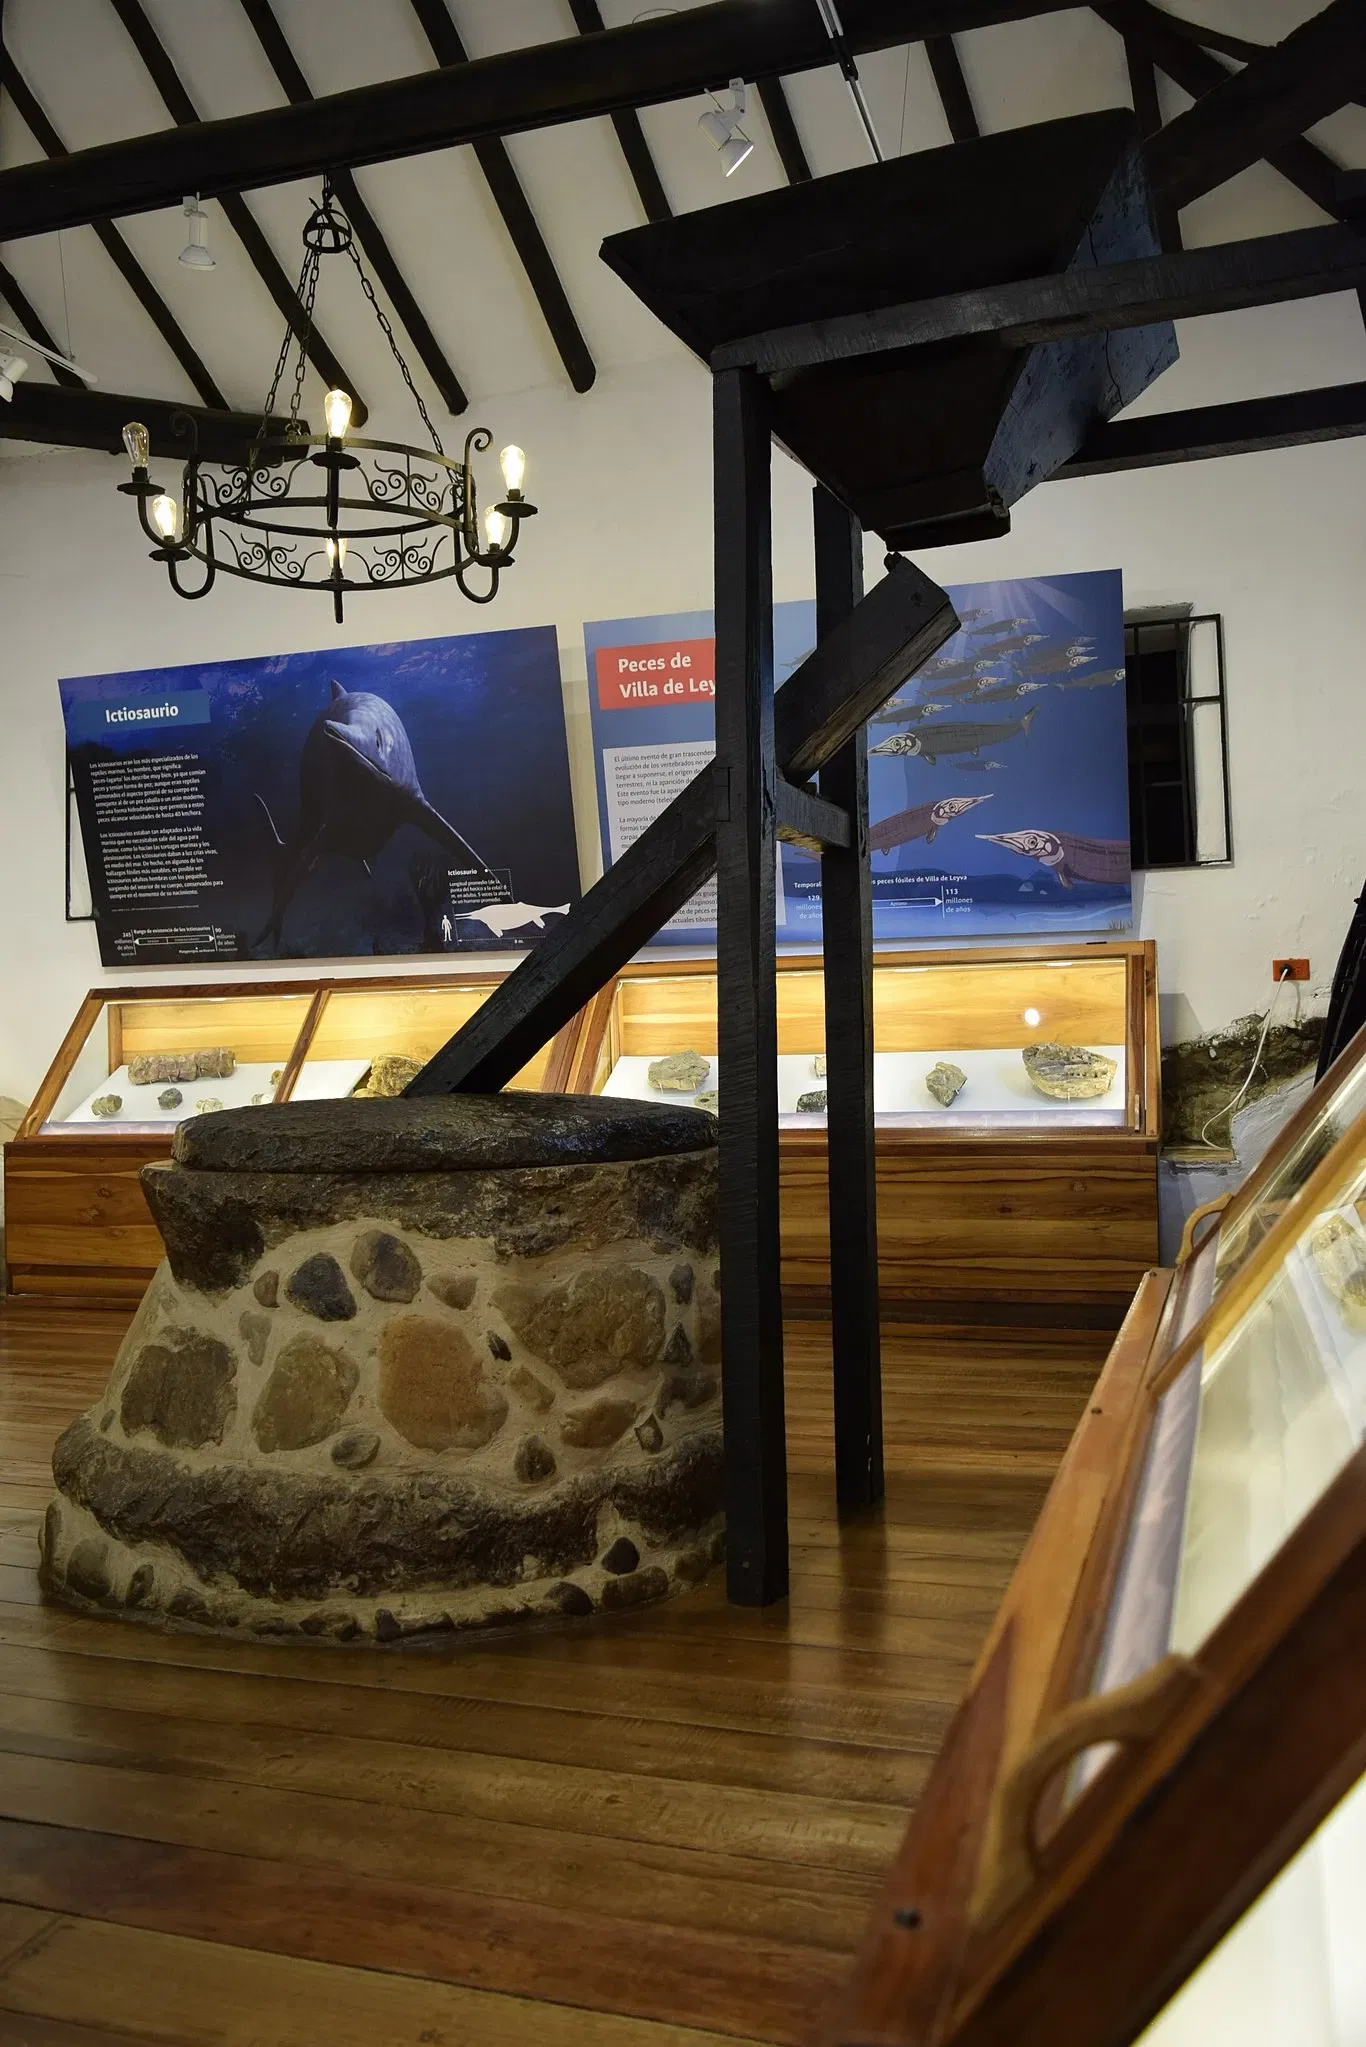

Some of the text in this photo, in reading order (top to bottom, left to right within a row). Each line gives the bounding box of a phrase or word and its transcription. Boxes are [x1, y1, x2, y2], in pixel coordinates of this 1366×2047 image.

[618, 652, 691, 673] Peces de
[619, 678, 715, 698] Villa de Ley
[105, 702, 179, 723] Ictiosaurio
[151, 755, 184, 764] especializados
[660, 760, 694, 768] vertebrados
[675, 769, 692, 777] origen
[144, 789, 160, 797] general
[627, 816, 648, 824] mayoría
[160, 827, 183, 835] adaptados
[447, 868, 477, 876] Ictiosaurio
